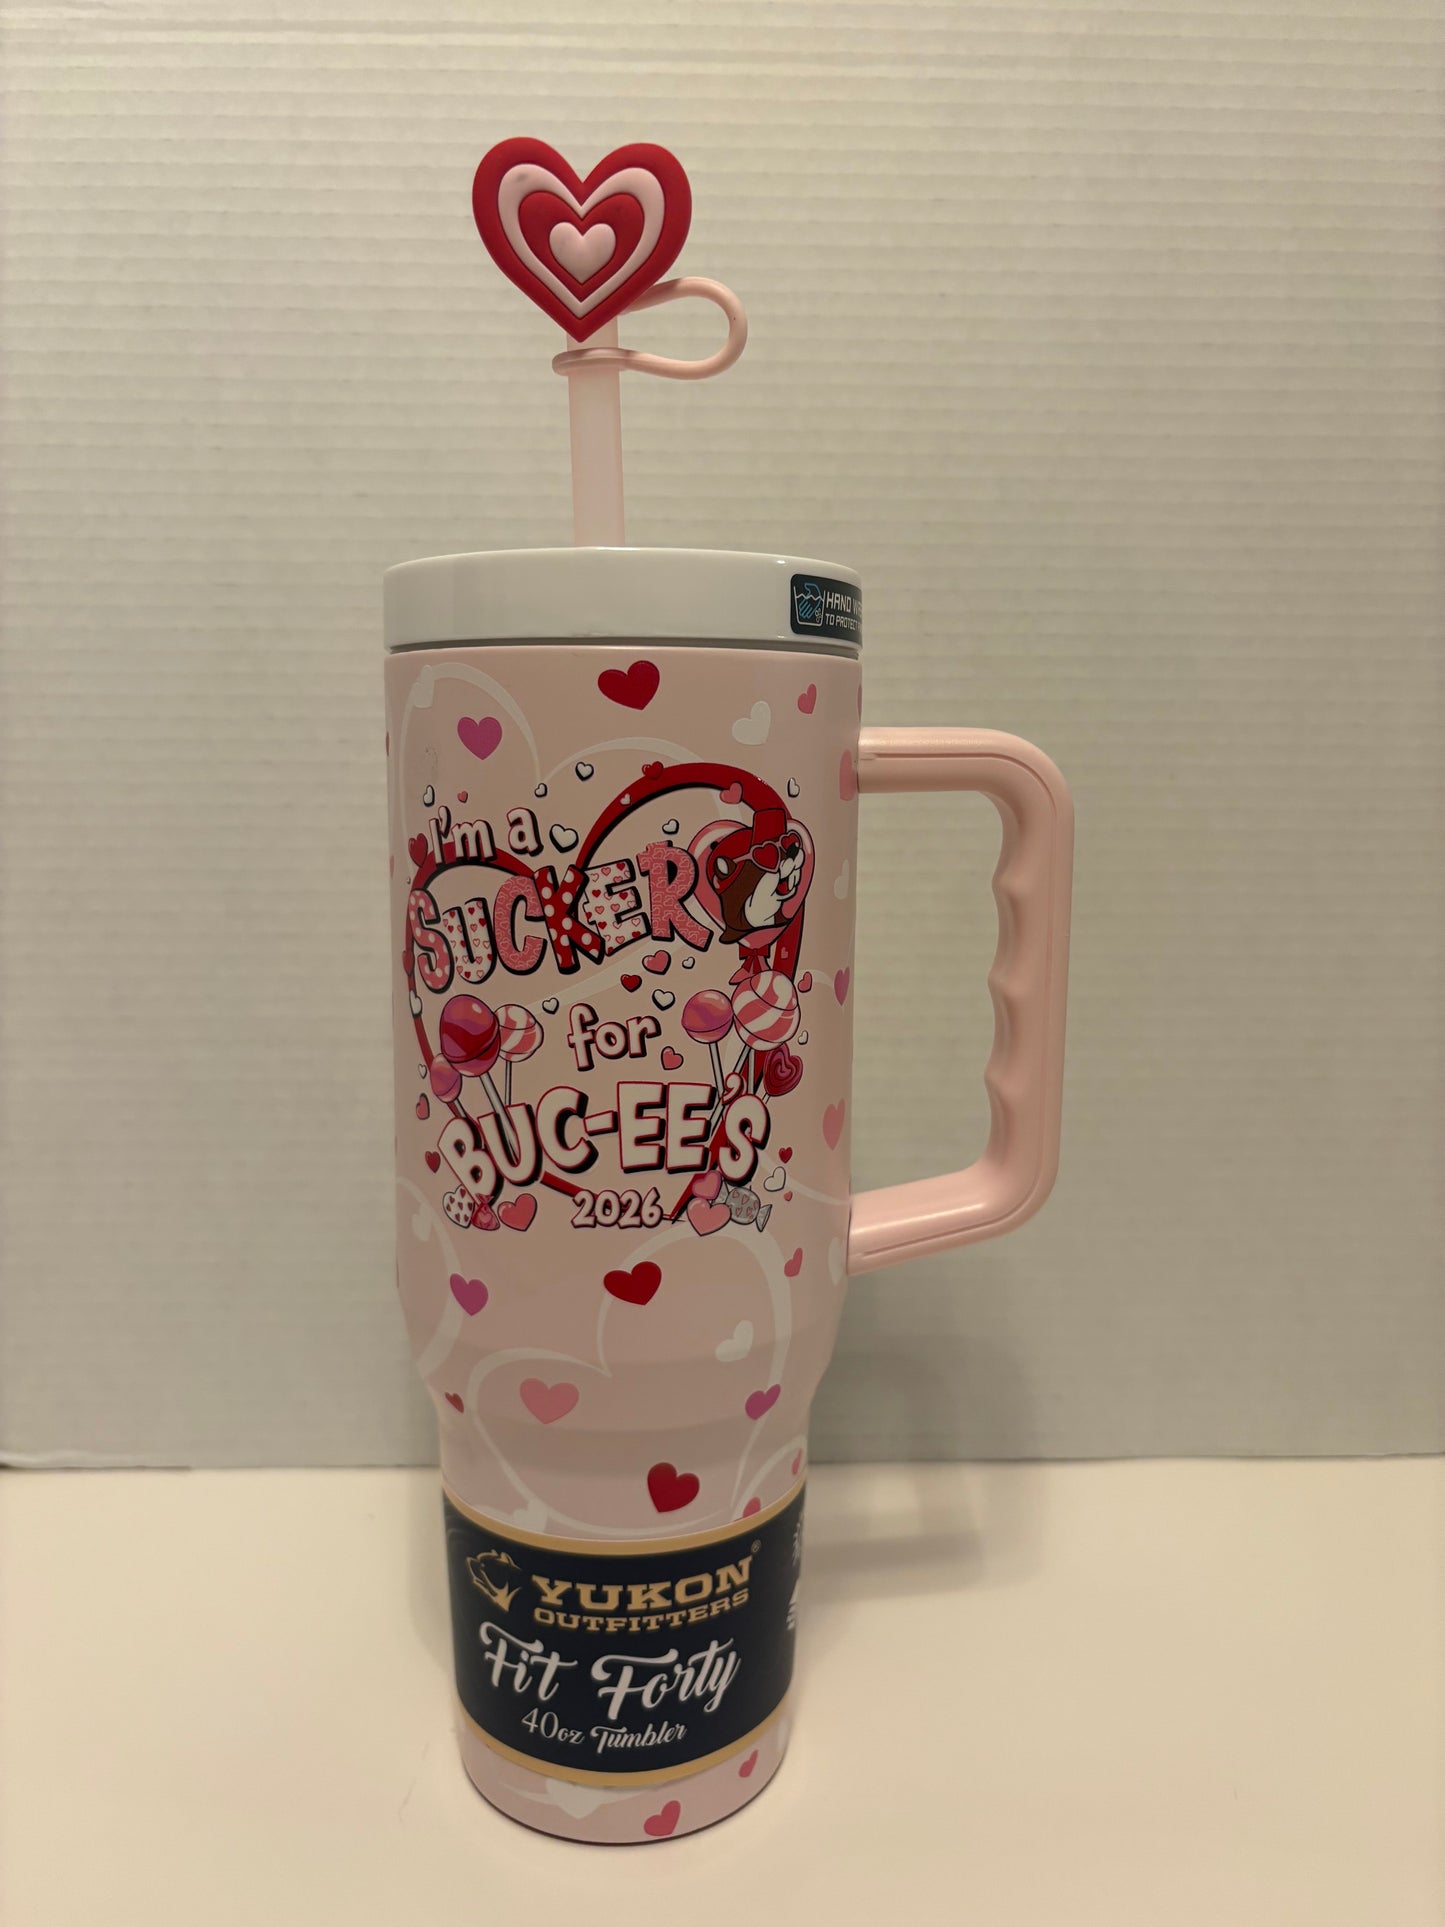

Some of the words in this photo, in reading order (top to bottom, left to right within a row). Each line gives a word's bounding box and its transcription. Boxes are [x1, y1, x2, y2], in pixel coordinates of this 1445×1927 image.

[825, 613, 834, 626] TO
[826, 591, 852, 613] HAND
[428, 805, 496, 864] I'm
[506, 806, 544, 857] a
[409, 840, 714, 994] SUCKER
[567, 1003, 661, 1071] for
[437, 1071, 771, 1207] BUC-EE'S
[571, 1186, 664, 1228] 2026
[531, 1555, 753, 1612] YUKON
[532, 1587, 750, 1633] OUTFITTERS
[479, 1620, 579, 1702] Fit
[590, 1637, 742, 1721] Forty
[521, 1707, 586, 1746] 40oz
[590, 1720, 688, 1754] Tumbler
